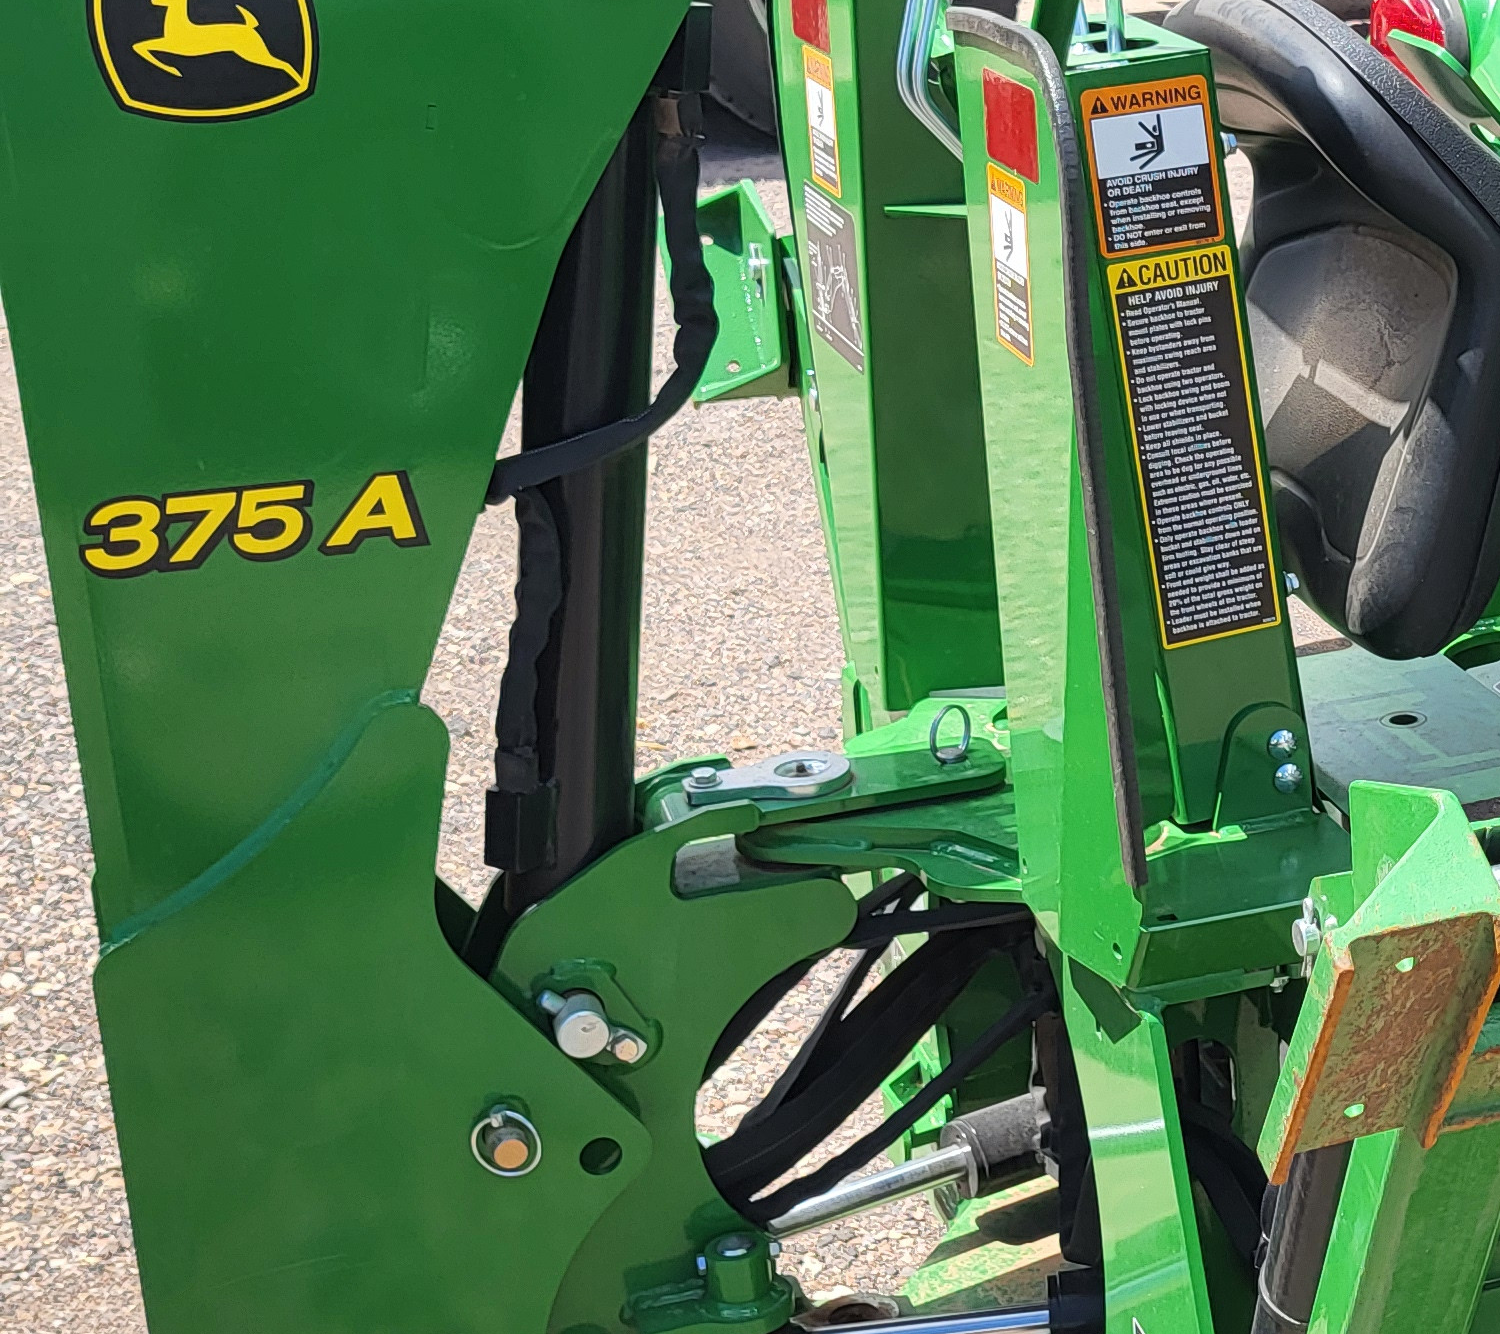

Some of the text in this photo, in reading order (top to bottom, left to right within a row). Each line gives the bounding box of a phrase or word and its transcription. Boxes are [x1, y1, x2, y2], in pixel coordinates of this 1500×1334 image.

[1110, 85, 1202, 112] WARNING
[1106, 166, 1198, 187] AVOID CRUSH INJURY
[1107, 183, 1152, 197] OR DEATH
[1139, 251, 1227, 285] CAUTION
[1127, 280, 1218, 305] HELP AVOID INJURY
